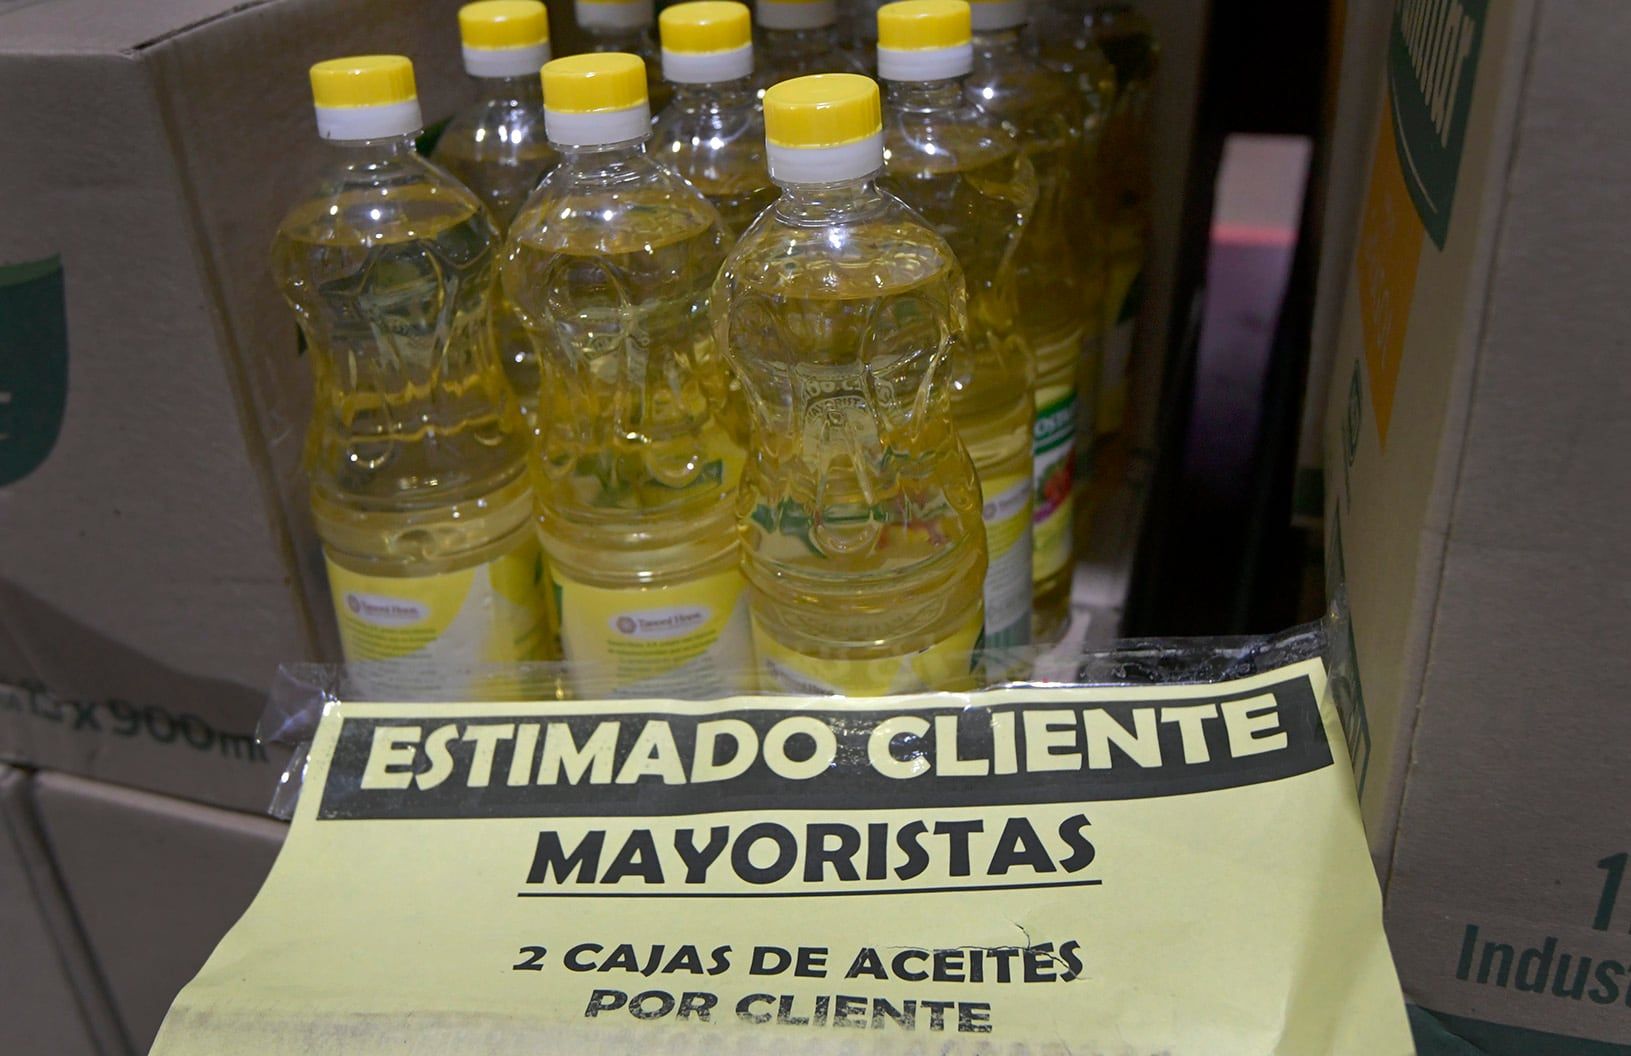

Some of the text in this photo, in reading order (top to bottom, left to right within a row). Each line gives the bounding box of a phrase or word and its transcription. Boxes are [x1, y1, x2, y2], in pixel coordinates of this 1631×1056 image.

[360, 692, 1288, 791] ESTIMADO CLIENTE
[526, 813, 1096, 885] MAYORISTAS
[1591, 851, 1631, 936] 1
[513, 939, 1083, 984] 2 CAJAS DE ACEITES
[585, 989, 993, 1034] POR CLIENTE
